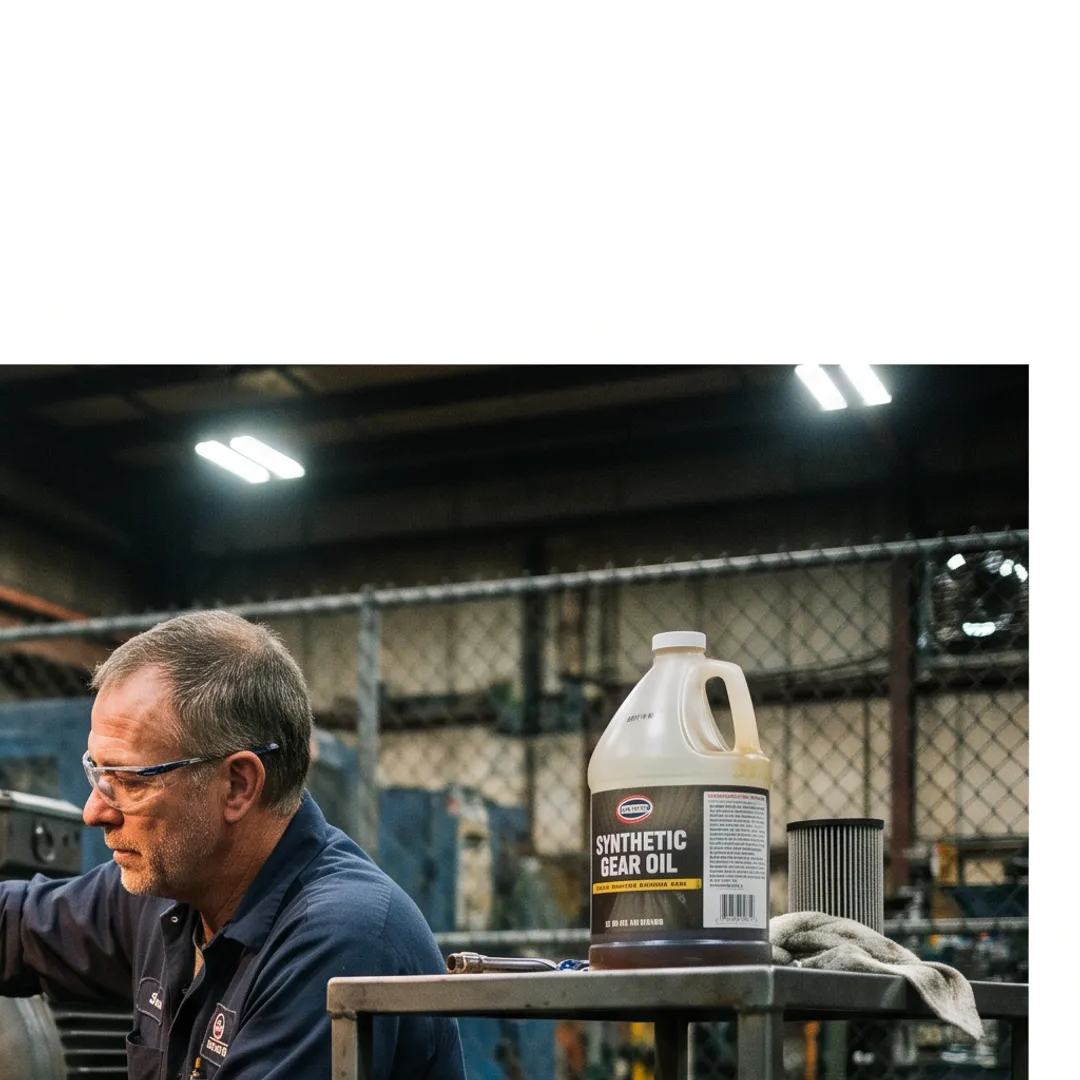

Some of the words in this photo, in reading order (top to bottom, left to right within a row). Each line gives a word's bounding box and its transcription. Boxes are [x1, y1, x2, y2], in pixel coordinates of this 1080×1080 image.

[596, 830, 687, 856] SYNTHETIC
[601, 855, 641, 877] GEAR
[646, 853, 678, 874] OIL
